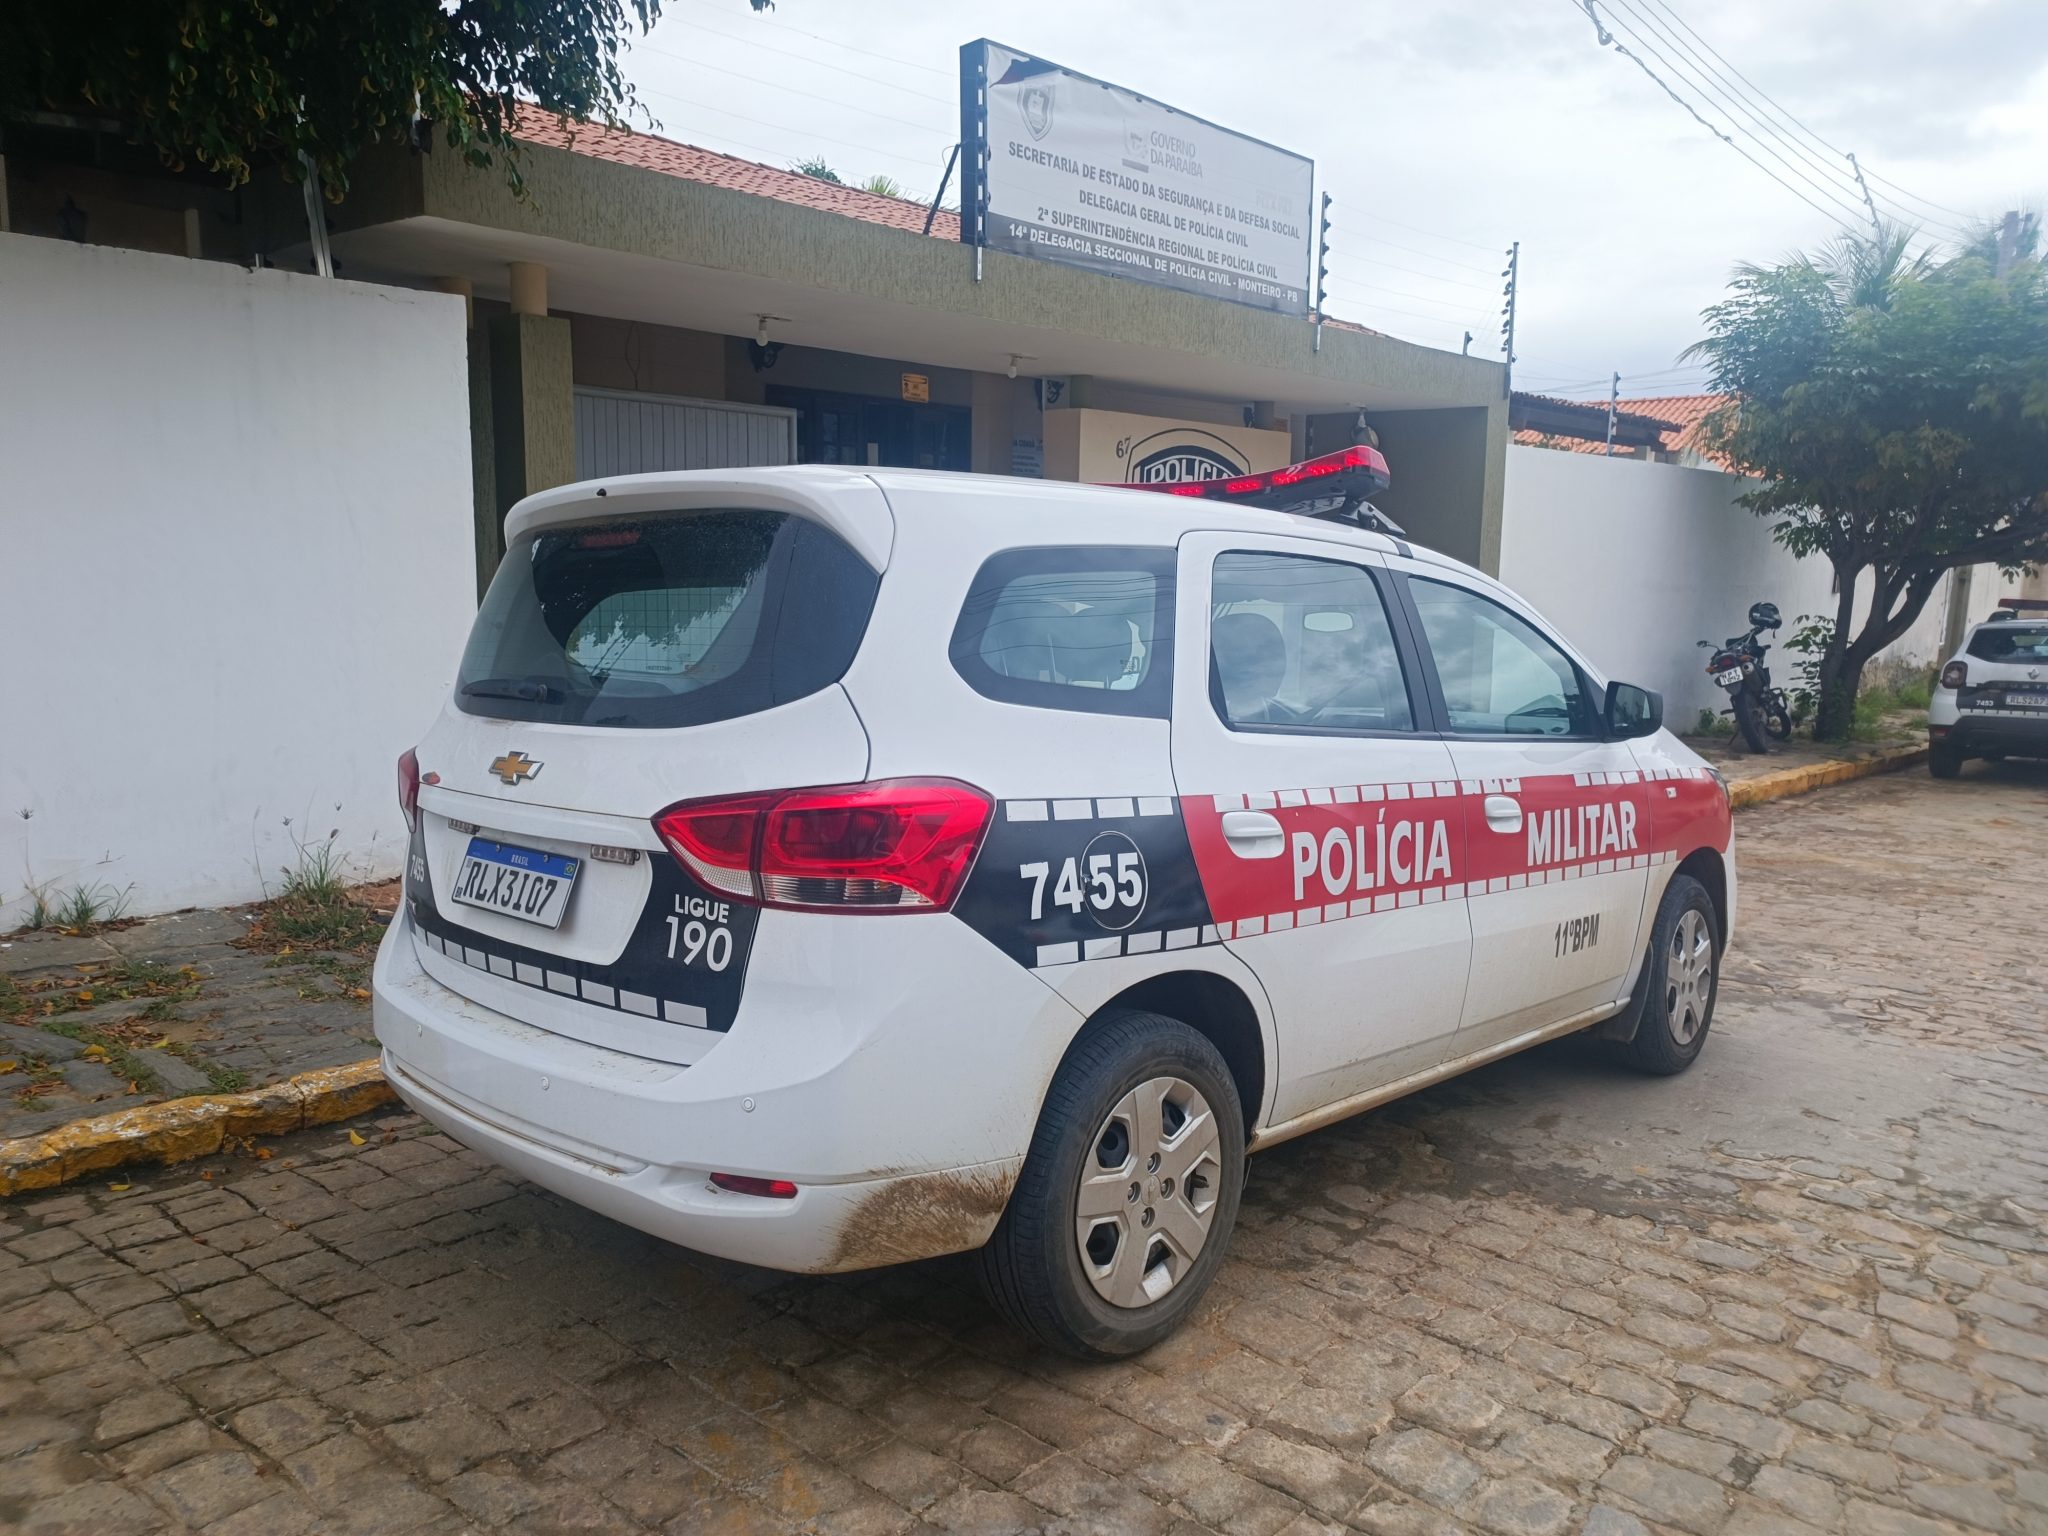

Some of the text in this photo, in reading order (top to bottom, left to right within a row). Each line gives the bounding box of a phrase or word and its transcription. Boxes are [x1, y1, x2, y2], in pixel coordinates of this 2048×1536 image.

[1150, 131, 1196, 158] GOVERNO
[1150, 149, 1164, 166] DA
[1009, 141, 1300, 239] SECRETARIA DE ESTADO DA SEGURANÇA E DA DEFESA SOCIAL
[1079, 189, 1248, 248] DELEGACIA GERAL DE POLÍCIA CIVIL
[1030, 228, 1092, 255] DELEGACIA
[1094, 244, 1152, 269] SECCIONAL
[1154, 258, 1168, 272] DE
[1169, 262, 1206, 281] POLÍCIA
[1208, 271, 1231, 286] CIVIL
[1238, 278, 1281, 298] MONTEIRO
[1287, 290, 1298, 302] PB
[1158, 237, 1205, 261] REGIONAL
[1207, 250, 1219, 264] DE
[1221, 253, 1255, 273] POLÍCIA
[1257, 263, 1278, 279] CIVIL
[1115, 435, 1131, 458] 67
[510, 854, 529, 866] BRASIL
[1292, 808, 1451, 900] POLÍCIA
[1527, 801, 1638, 867] MILITAR
[675, 894, 730, 924] LIGUE
[1020, 852, 1142, 920] 7455
[666, 915, 733, 972] 190
